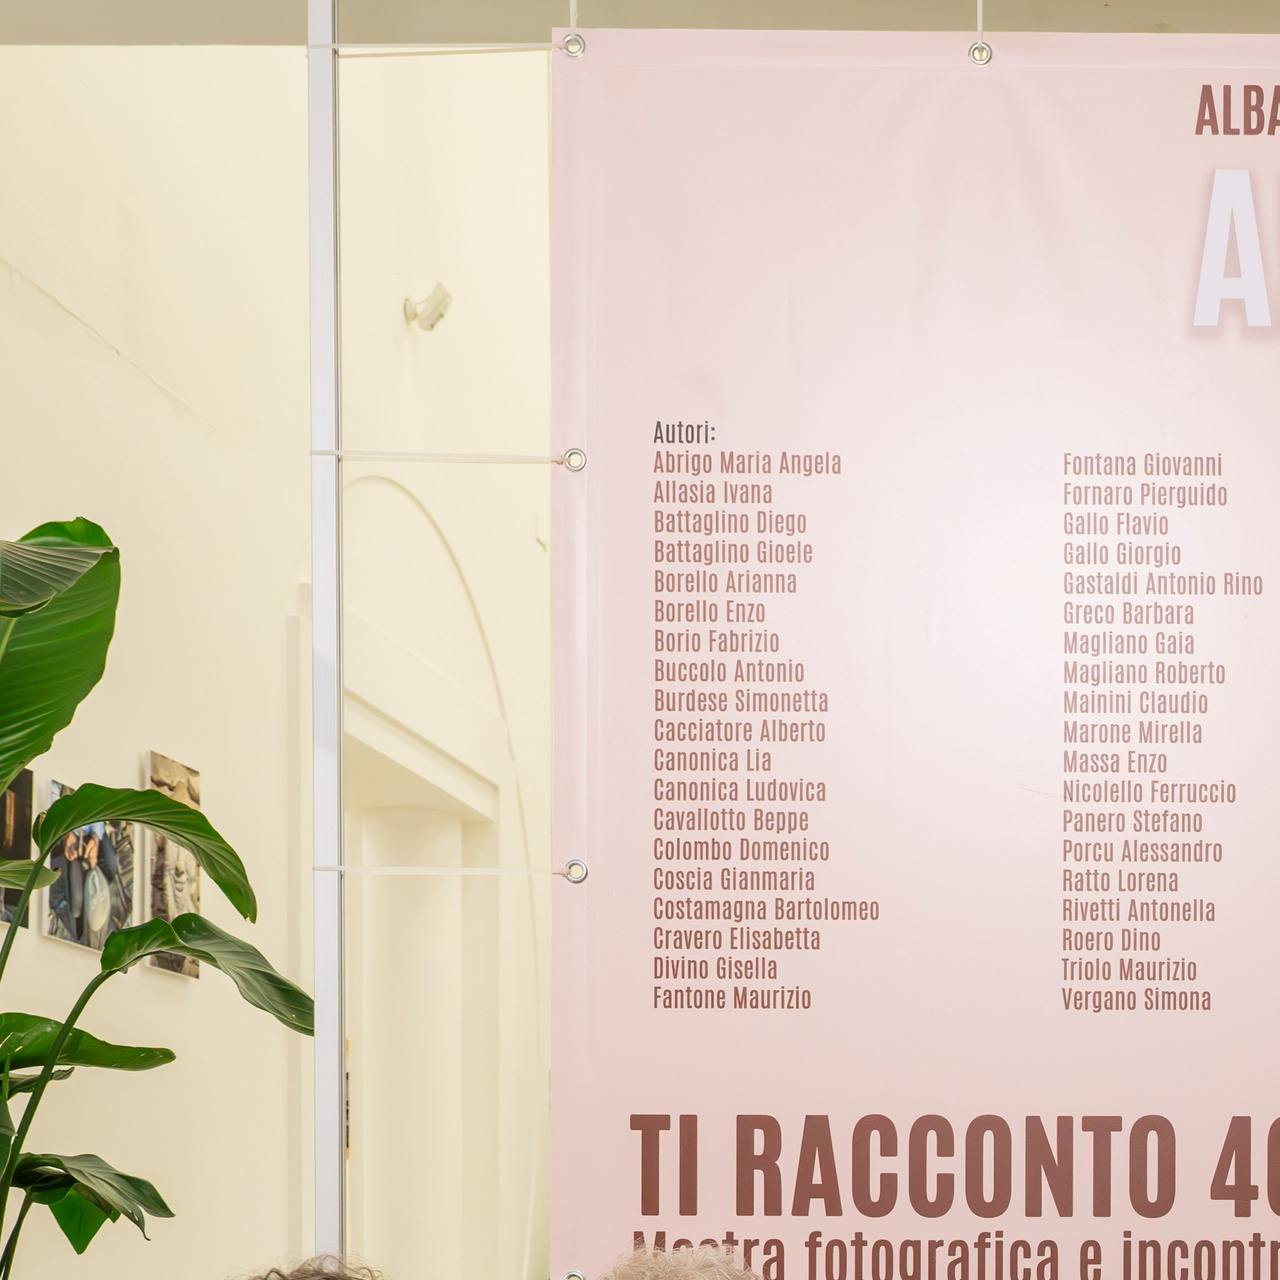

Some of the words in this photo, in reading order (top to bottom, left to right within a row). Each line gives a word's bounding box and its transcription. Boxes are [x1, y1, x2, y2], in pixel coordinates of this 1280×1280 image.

[653, 420, 716, 445] Autori:
[653, 449, 713, 477] Abrigo
[720, 450, 772, 475] Maria
[778, 451, 842, 478] Angela
[1063, 452, 1136, 476] Fontana
[1143, 452, 1222, 477] Giovanni
[1063, 482, 1133, 506] Fornaro
[1140, 482, 1228, 509] Pierguido
[654, 509, 749, 536] Battaglino
[757, 509, 807, 537] Diego
[1063, 511, 1109, 535] Gallo
[1117, 512, 1169, 536] Flavio
[654, 539, 749, 566] Battaglino
[757, 539, 813, 564] Gioele
[1063, 541, 1109, 565] Gallo
[1116, 541, 1181, 568] Giorgio
[654, 569, 718, 593] Borello
[725, 569, 797, 594] Arianna
[1063, 571, 1138, 595] Gastaldi
[1145, 571, 1216, 596] Antonio
[1223, 571, 1263, 596] Rino
[1063, 601, 1115, 625] Greco
[1123, 601, 1194, 625] Barbara
[654, 628, 701, 653] Borio
[709, 629, 780, 653] Fabrizio
[1063, 630, 1148, 657] Magliano
[1155, 631, 1195, 655] Gaia
[654, 658, 727, 683] Buccolo
[734, 658, 805, 683] Antonio
[1063, 690, 1132, 714] Mainini
[1139, 690, 1208, 715] Claudio
[654, 718, 753, 742] Cacciatore
[759, 719, 826, 743] Alberto
[1063, 720, 1131, 744] Marone
[1139, 720, 1202, 744] Mirella
[653, 747, 739, 772] Canonica
[746, 748, 772, 772] Lia
[653, 777, 738, 802] Canonica
[746, 777, 826, 802] Ludovica
[1063, 779, 1143, 803] Nicolello
[1151, 779, 1237, 804] Ferruccio
[653, 837, 732, 861] Colombo
[740, 837, 830, 862] Domenico
[1062, 839, 1114, 863] Porcu
[1121, 839, 1223, 863] Alessandro
[653, 866, 713, 891] Coscia
[720, 866, 815, 891] Gianmaria
[1062, 868, 1111, 892] Ratto
[1118, 869, 1179, 893] Lorena
[653, 896, 767, 923] Costamagna
[774, 897, 880, 921] Bartolomeo
[1062, 897, 1120, 922] Rivetti
[1127, 898, 1216, 922] Antonella
[1062, 928, 1114, 952] Roero
[1121, 927, 1161, 952] Dino
[653, 955, 709, 980] Divino
[716, 956, 778, 980] Gisella
[1060, 957, 1112, 981] Triolo
[1119, 957, 1197, 982] Maurizio
[653, 985, 726, 1010] Fantone
[733, 985, 812, 1010] Maurizio
[1061, 987, 1137, 1014] Vergano
[1144, 986, 1212, 1011] Simona
[630, 1115, 697, 1216] TI
[736, 1114, 1175, 1218] RACCONTO
